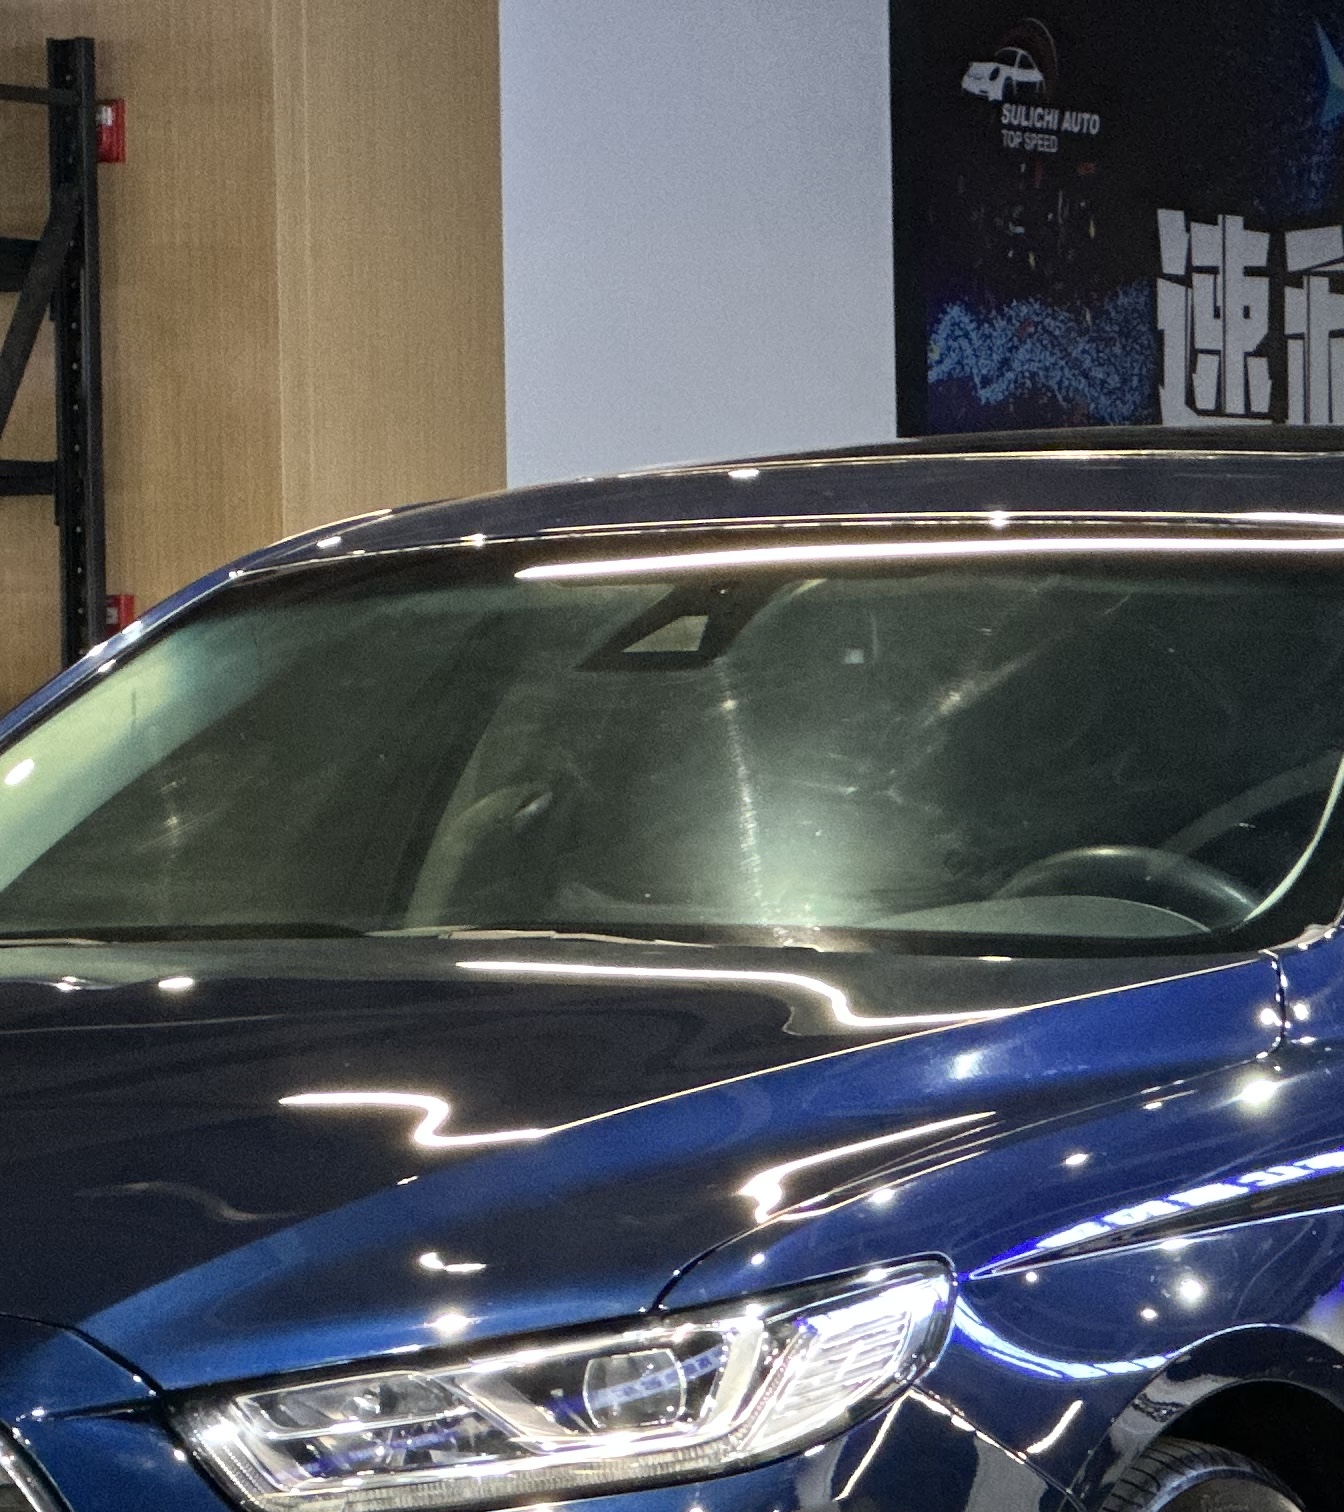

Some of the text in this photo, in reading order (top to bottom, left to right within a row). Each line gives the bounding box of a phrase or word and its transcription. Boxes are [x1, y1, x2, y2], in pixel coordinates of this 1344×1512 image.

[1001, 103, 1100, 135] SULICHI AUTO
[1001, 129, 1058, 153] TOP SPEED
